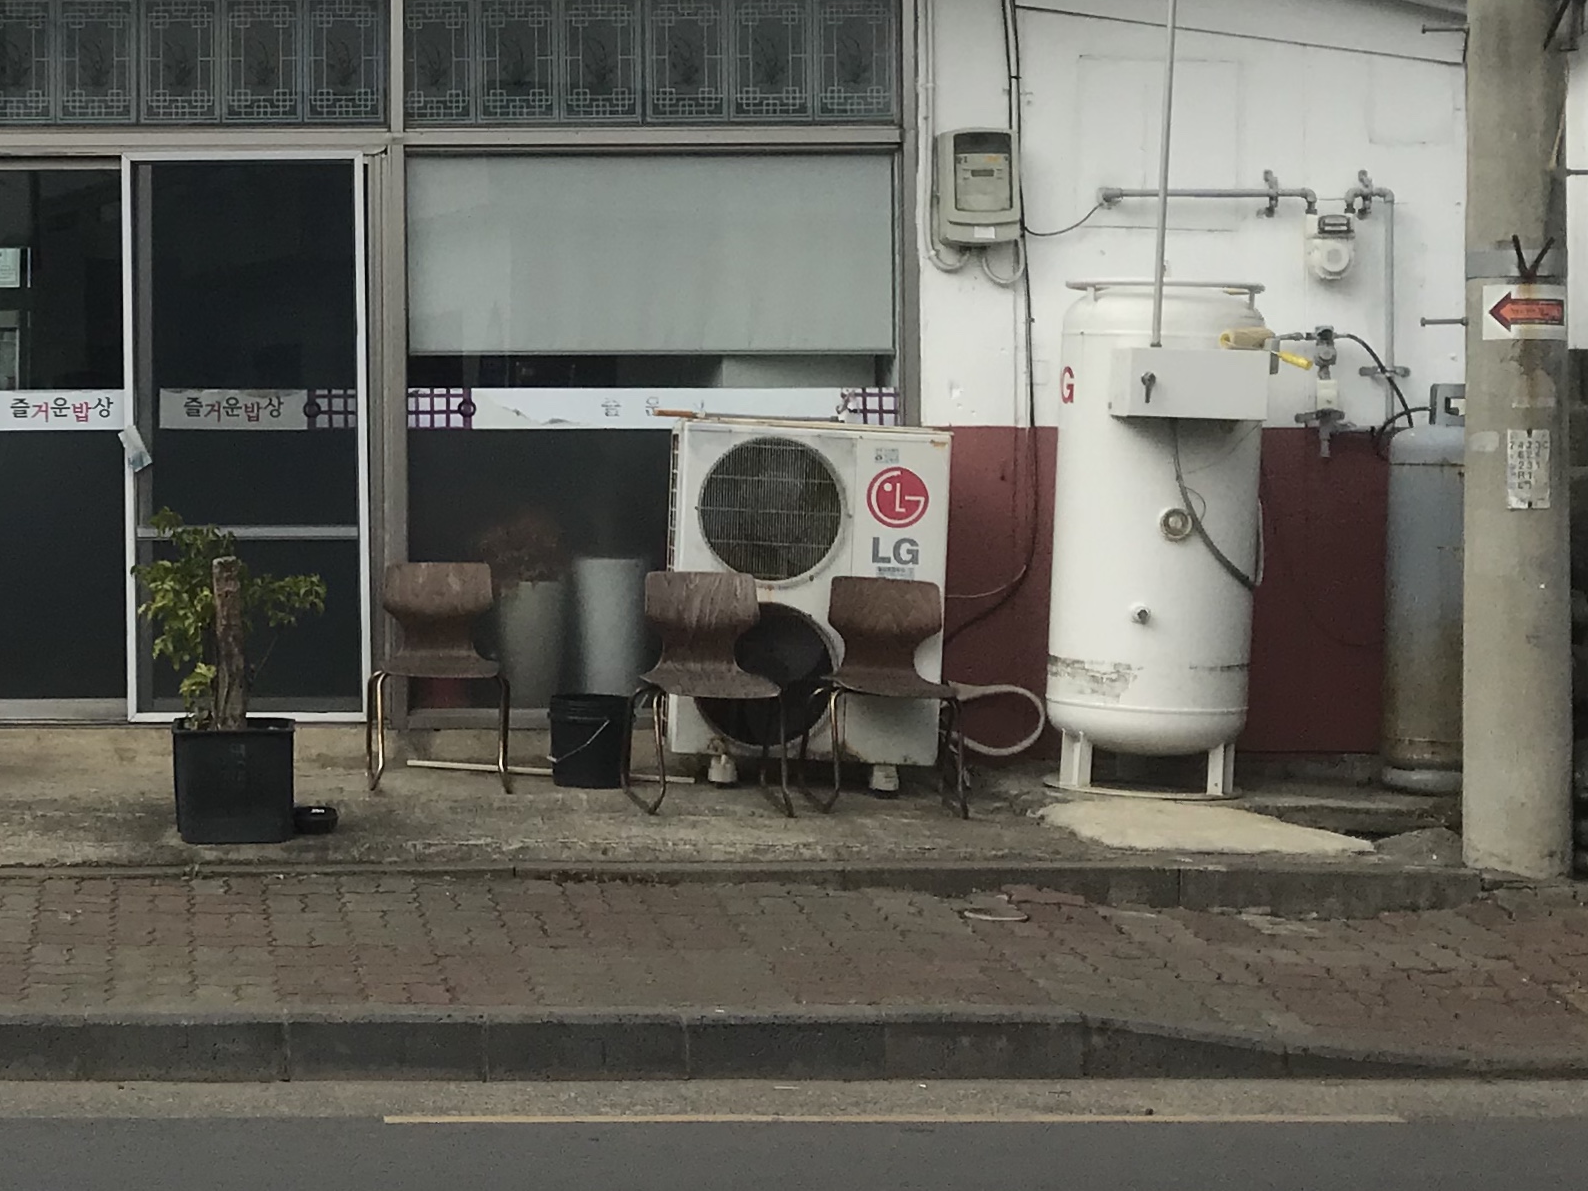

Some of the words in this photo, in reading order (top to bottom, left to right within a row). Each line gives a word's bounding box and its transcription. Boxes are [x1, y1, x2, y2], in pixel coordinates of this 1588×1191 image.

[10, 396, 114, 423] 즐거운밥상
[183, 396, 284, 423] 즐거운밥상
[872, 537, 919, 565] LG
